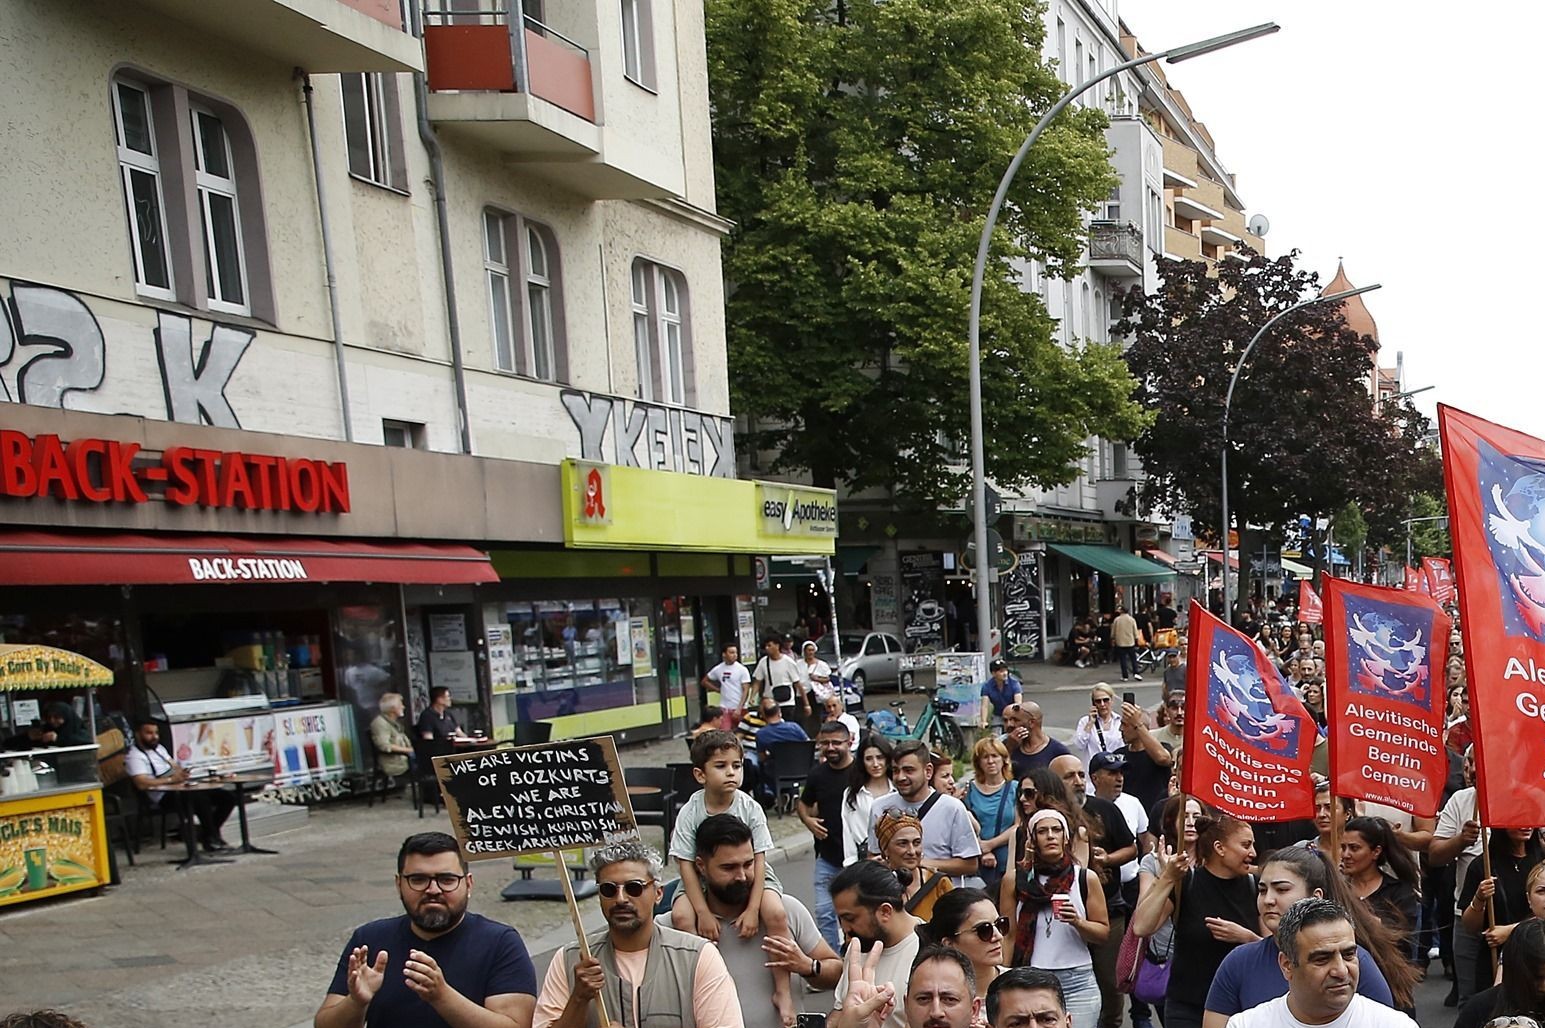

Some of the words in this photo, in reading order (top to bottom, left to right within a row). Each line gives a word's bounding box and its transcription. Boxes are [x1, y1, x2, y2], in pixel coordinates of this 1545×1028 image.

[0, 429, 351, 514] BACK-STATION
[764, 500, 787, 524] easy
[792, 498, 836, 525] Apotheke
[188, 556, 308, 581] BACK-STATION
[1345, 703, 1438, 738] Alevitische
[1202, 725, 1302, 777] Alevitische
[1349, 723, 1438, 755] Gemeinde
[450, 758, 477, 776] WE
[479, 751, 512, 769] ARE
[515, 748, 590, 764] VICTIMS
[1368, 745, 1421, 770] Berlin
[478, 773, 498, 787] OF
[510, 768, 609, 786] BOZKURTS
[1220, 770, 1277, 798] Berlin
[1361, 764, 1426, 792] Cemevi
[511, 789, 543, 804] WE
[548, 785, 582, 801] ARE
[0, 816, 43, 842] CLE'S
[48, 817, 82, 837] MAIS
